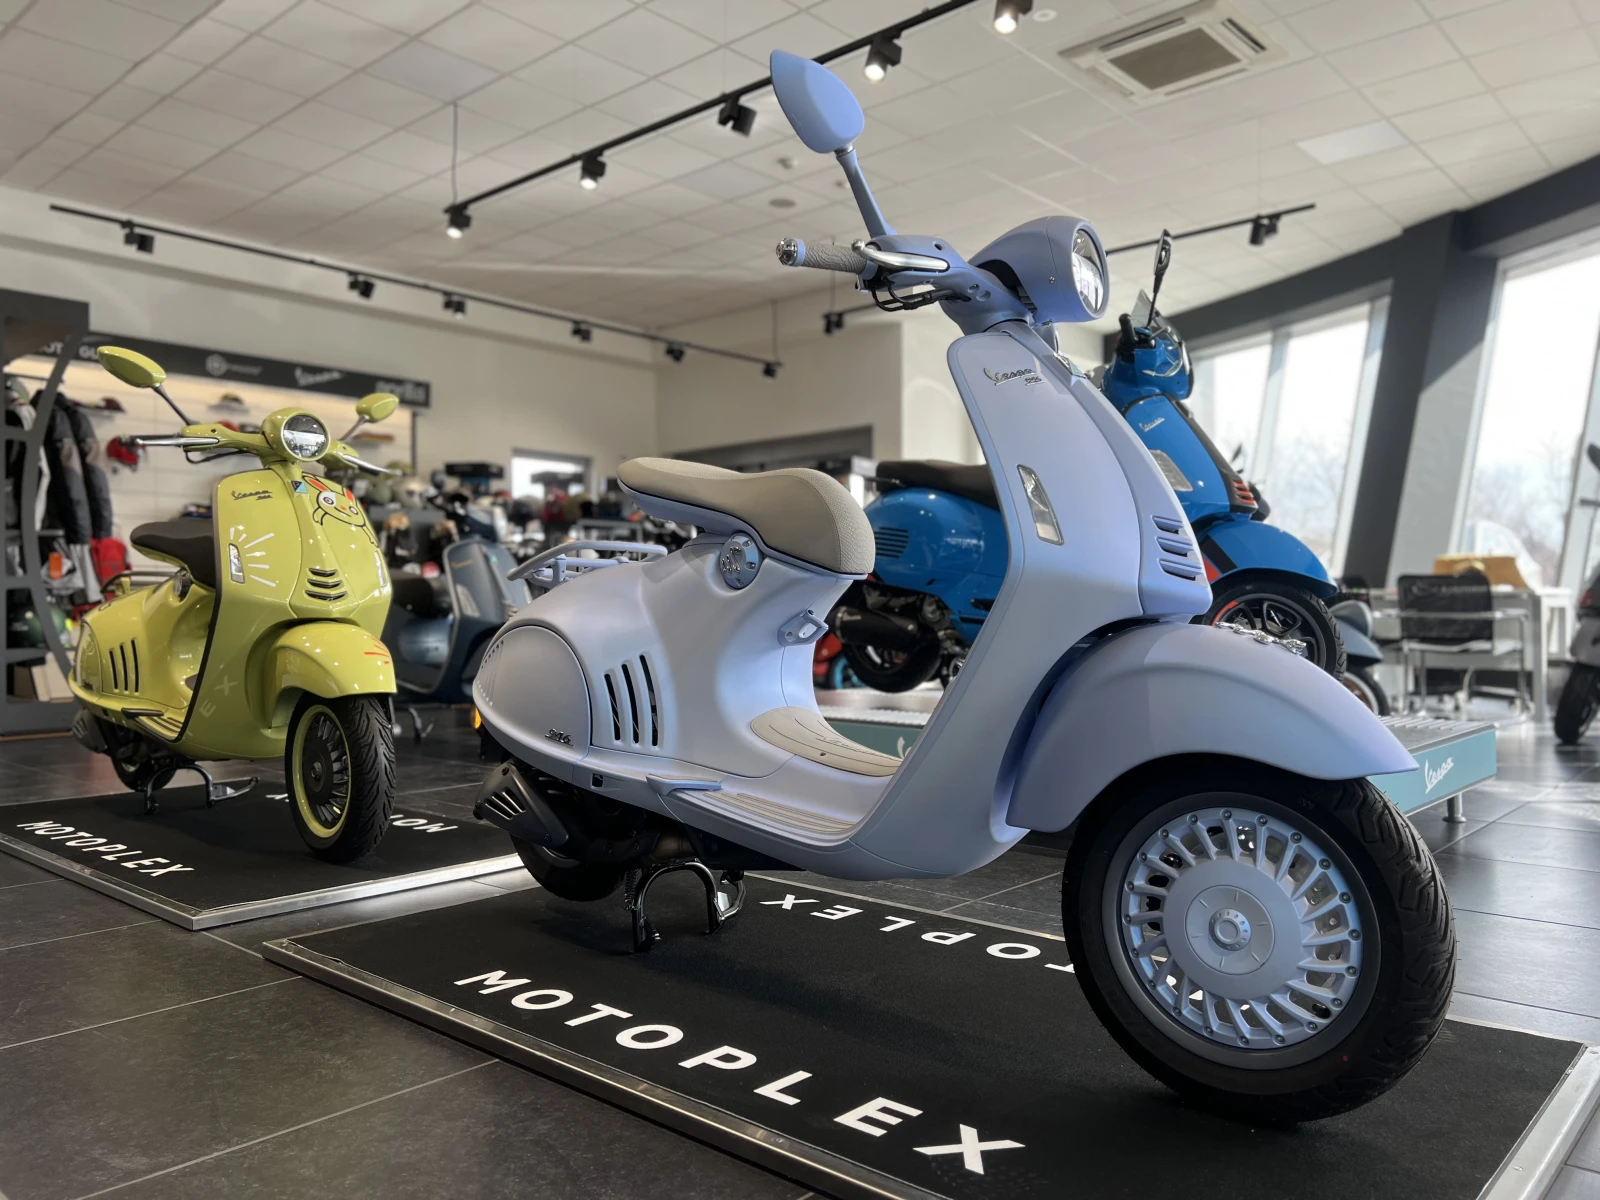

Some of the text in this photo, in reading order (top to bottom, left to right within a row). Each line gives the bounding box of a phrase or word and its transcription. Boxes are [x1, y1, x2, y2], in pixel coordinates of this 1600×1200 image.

[983, 367, 1037, 386] Vespa
[544, 728, 573, 747] 946
[1425, 757, 1454, 795] Vespa
[16, 821, 195, 877] MOTOPLEX
[759, 893, 1077, 974] TOPLEX
[454, 970, 1026, 1176] MOTOPLEX
